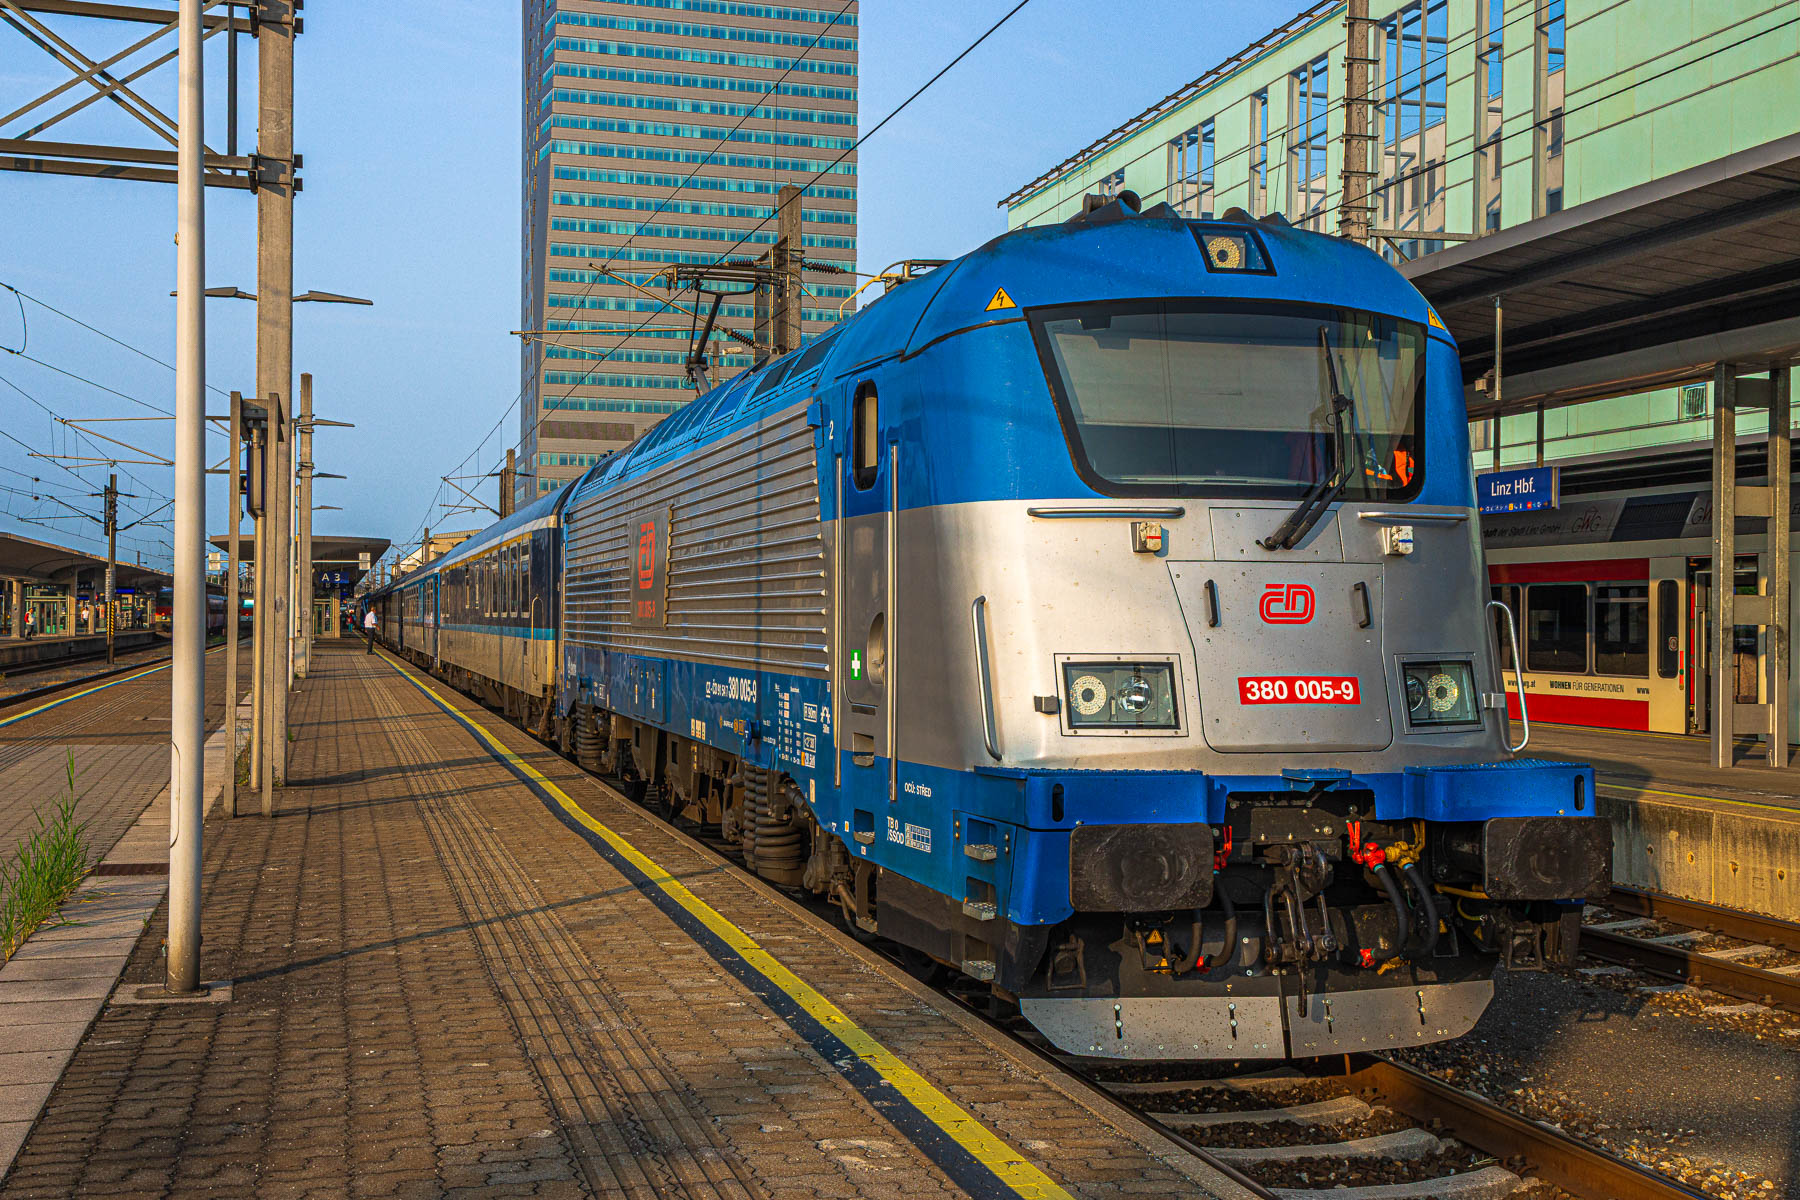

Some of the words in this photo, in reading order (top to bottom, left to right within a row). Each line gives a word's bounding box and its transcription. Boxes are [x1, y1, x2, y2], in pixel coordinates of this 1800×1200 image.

[829, 420, 834, 440] 2
[1491, 481, 1512, 496] Linz
[1514, 477, 1536, 494] Hbf.
[322, 573, 329, 581] A
[728, 676, 739, 700] 380
[740, 678, 757, 704] 005-9
[1245, 680, 1288, 700] 380
[1294, 680, 1355, 700] 005-9
[1550, 680, 1571, 689] WOHNEN
[1573, 680, 1582, 690] FÜR
[1584, 682, 1624, 692] GENERATIONEN
[917, 784, 932, 797] STŘED
[887, 828, 904, 844] /SSOD
